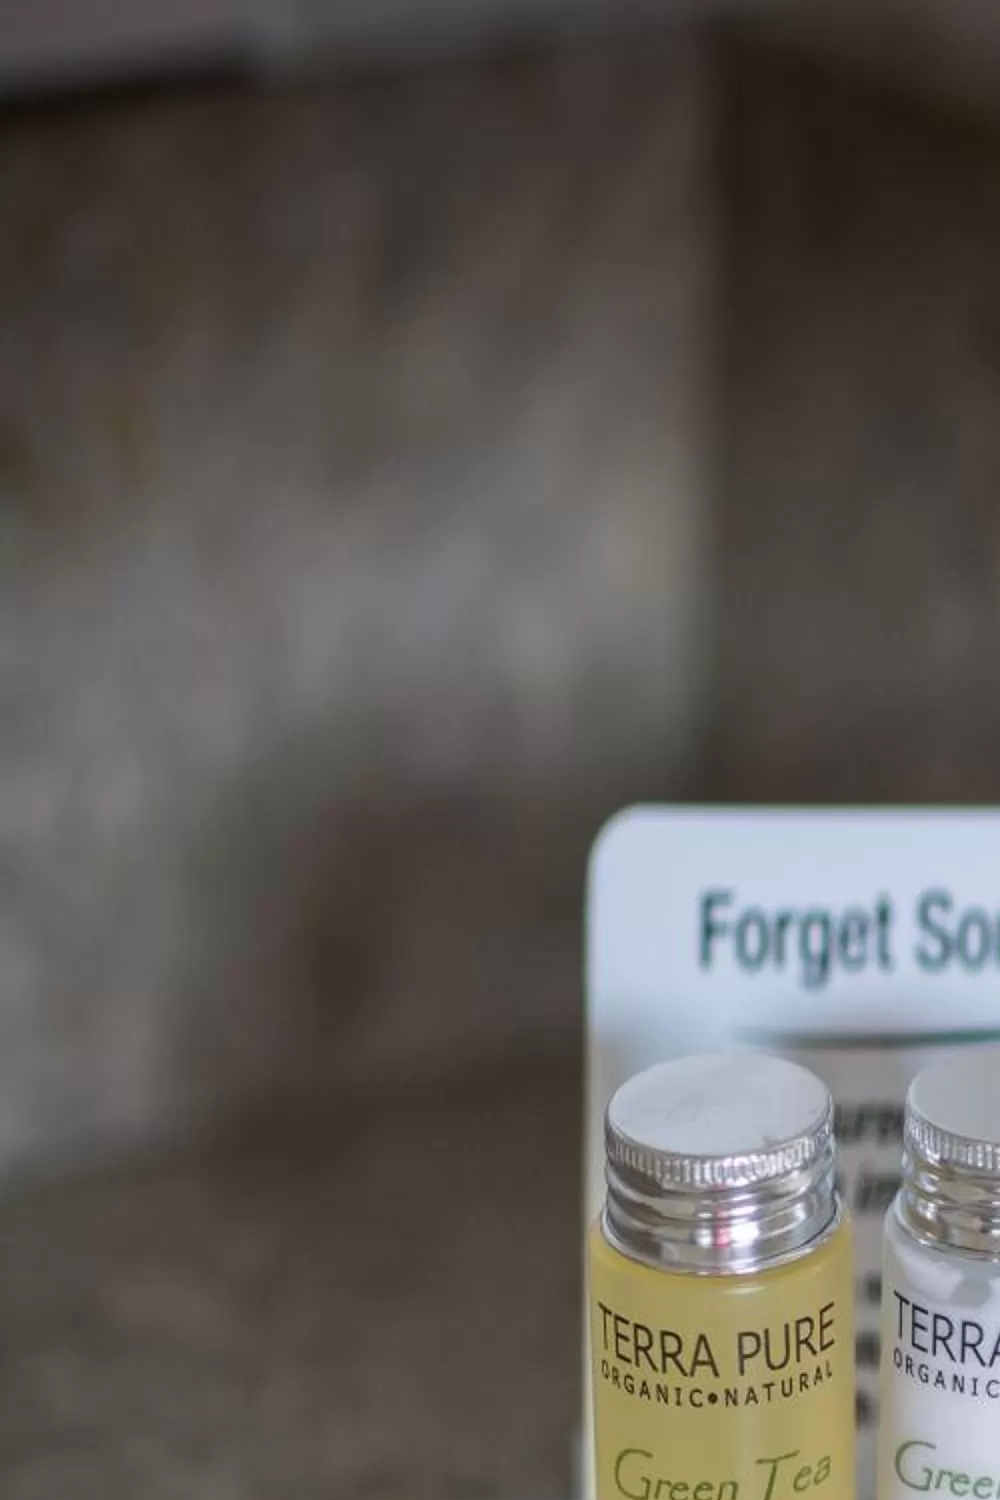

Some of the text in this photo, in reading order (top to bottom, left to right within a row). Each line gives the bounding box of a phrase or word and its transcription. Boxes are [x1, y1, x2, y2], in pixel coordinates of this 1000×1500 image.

[697, 887, 893, 990] Forget
[597, 1301, 720, 1378] TERRA
[737, 1301, 835, 1376] PURE
